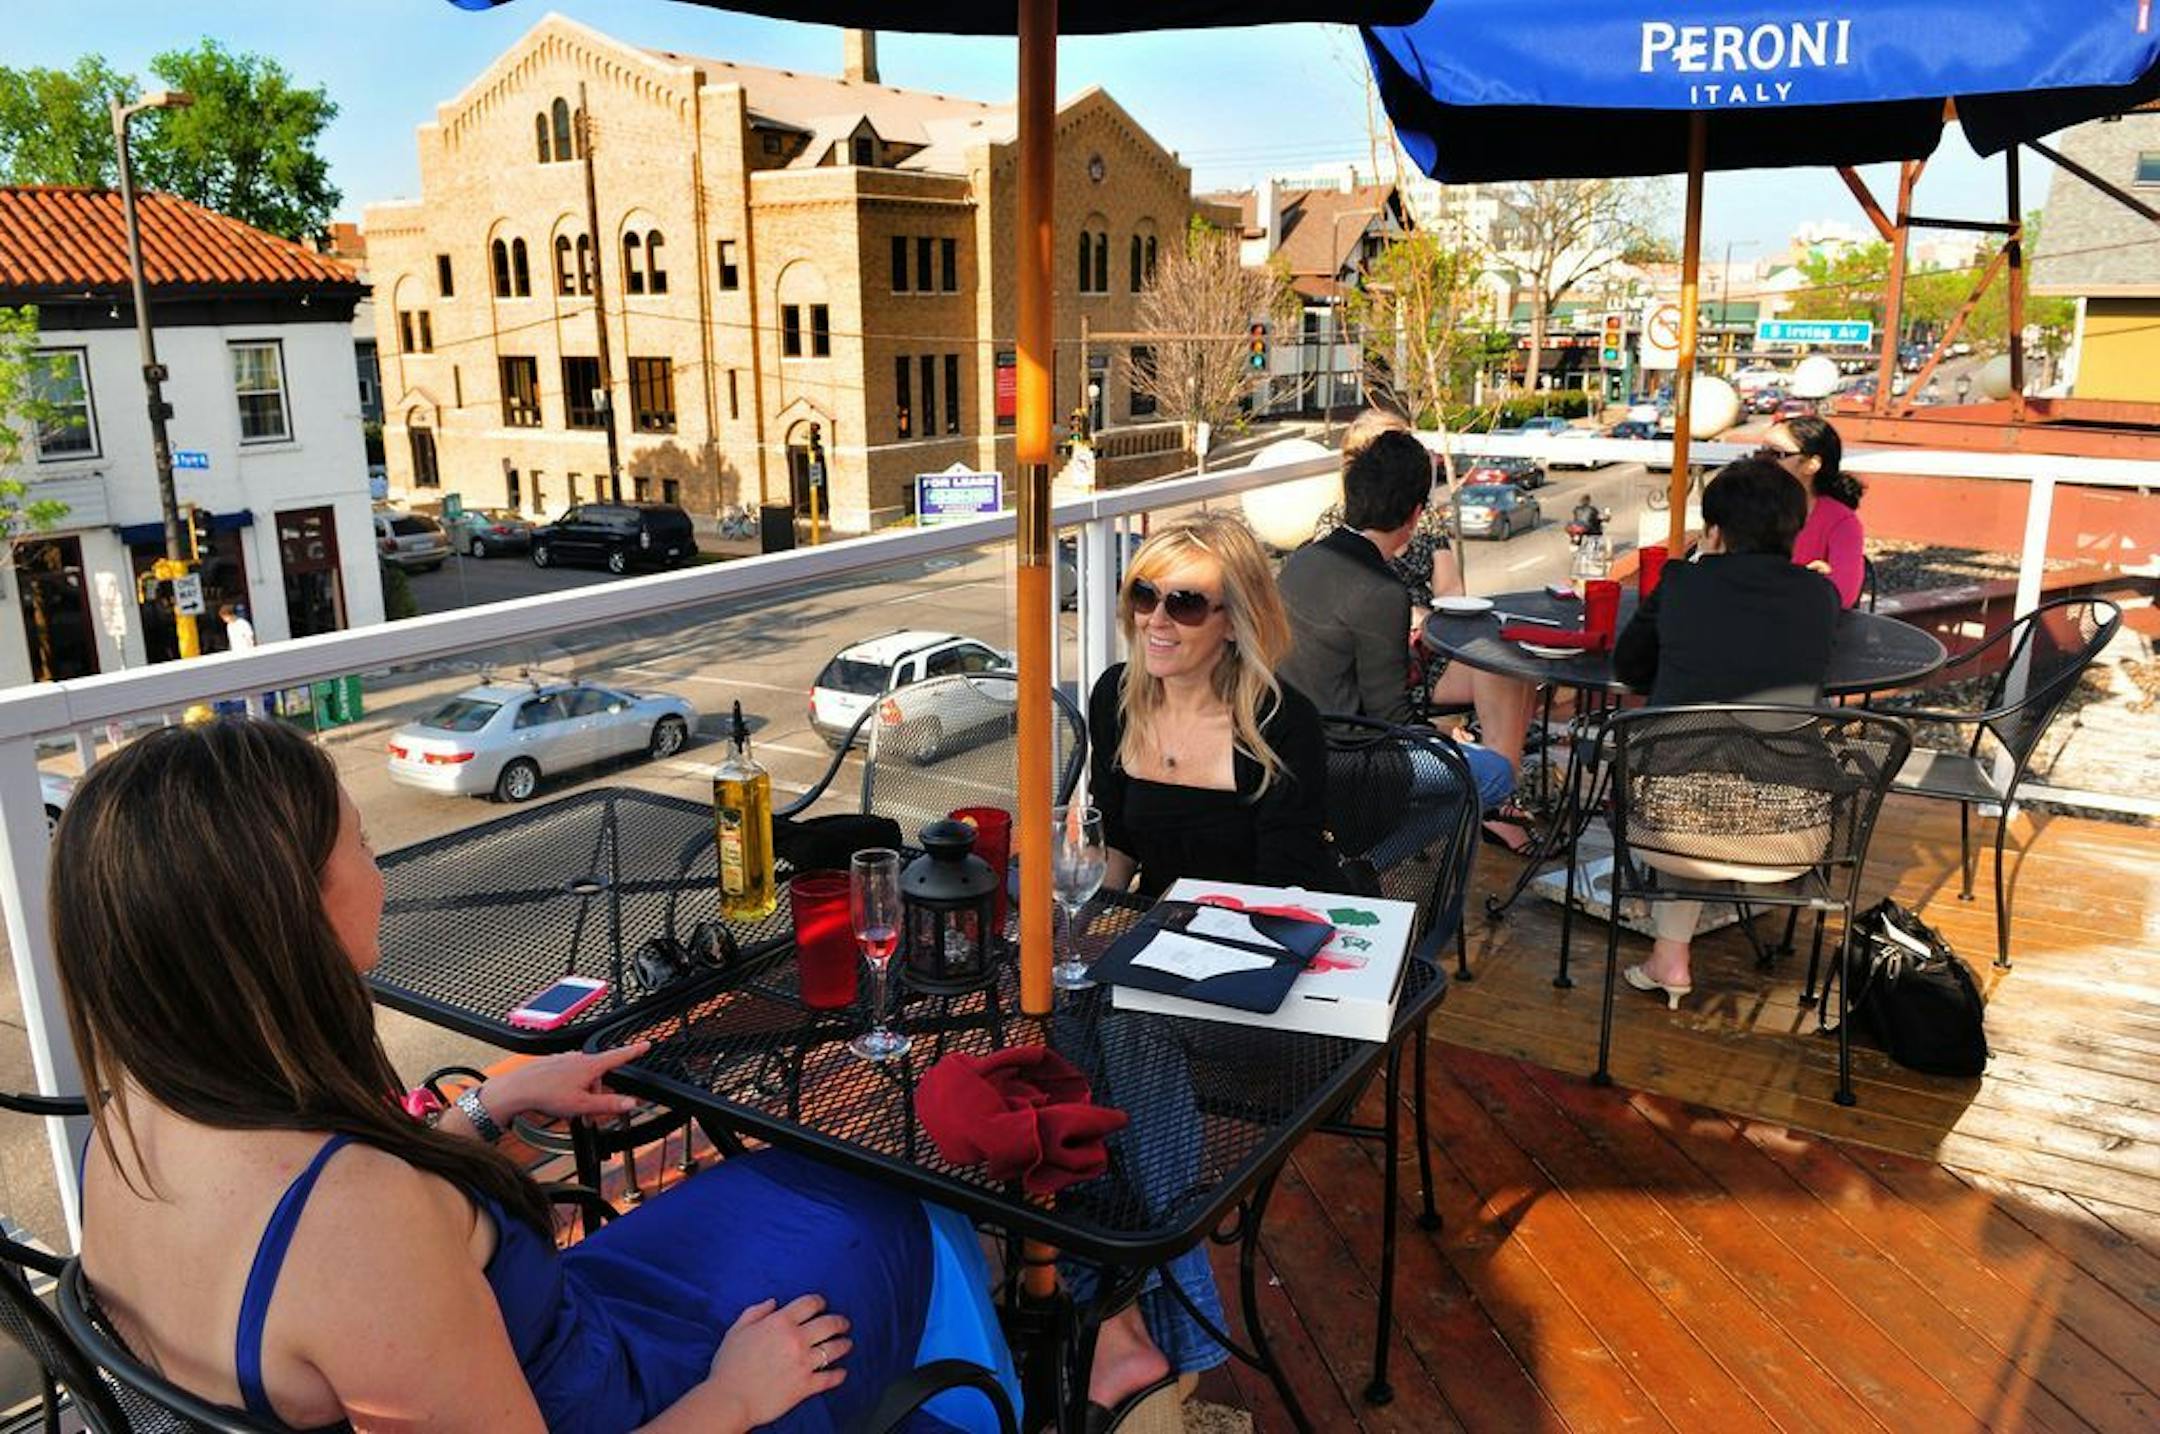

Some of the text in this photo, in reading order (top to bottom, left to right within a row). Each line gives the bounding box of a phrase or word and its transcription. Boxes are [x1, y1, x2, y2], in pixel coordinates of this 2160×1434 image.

[1640, 20, 1851, 73] PERONI
[1690, 82, 1793, 105] ITALY
[1786, 325, 1832, 341] Irving
[1837, 325, 1859, 339] Av
[922, 475, 997, 489] FOR LEASE
